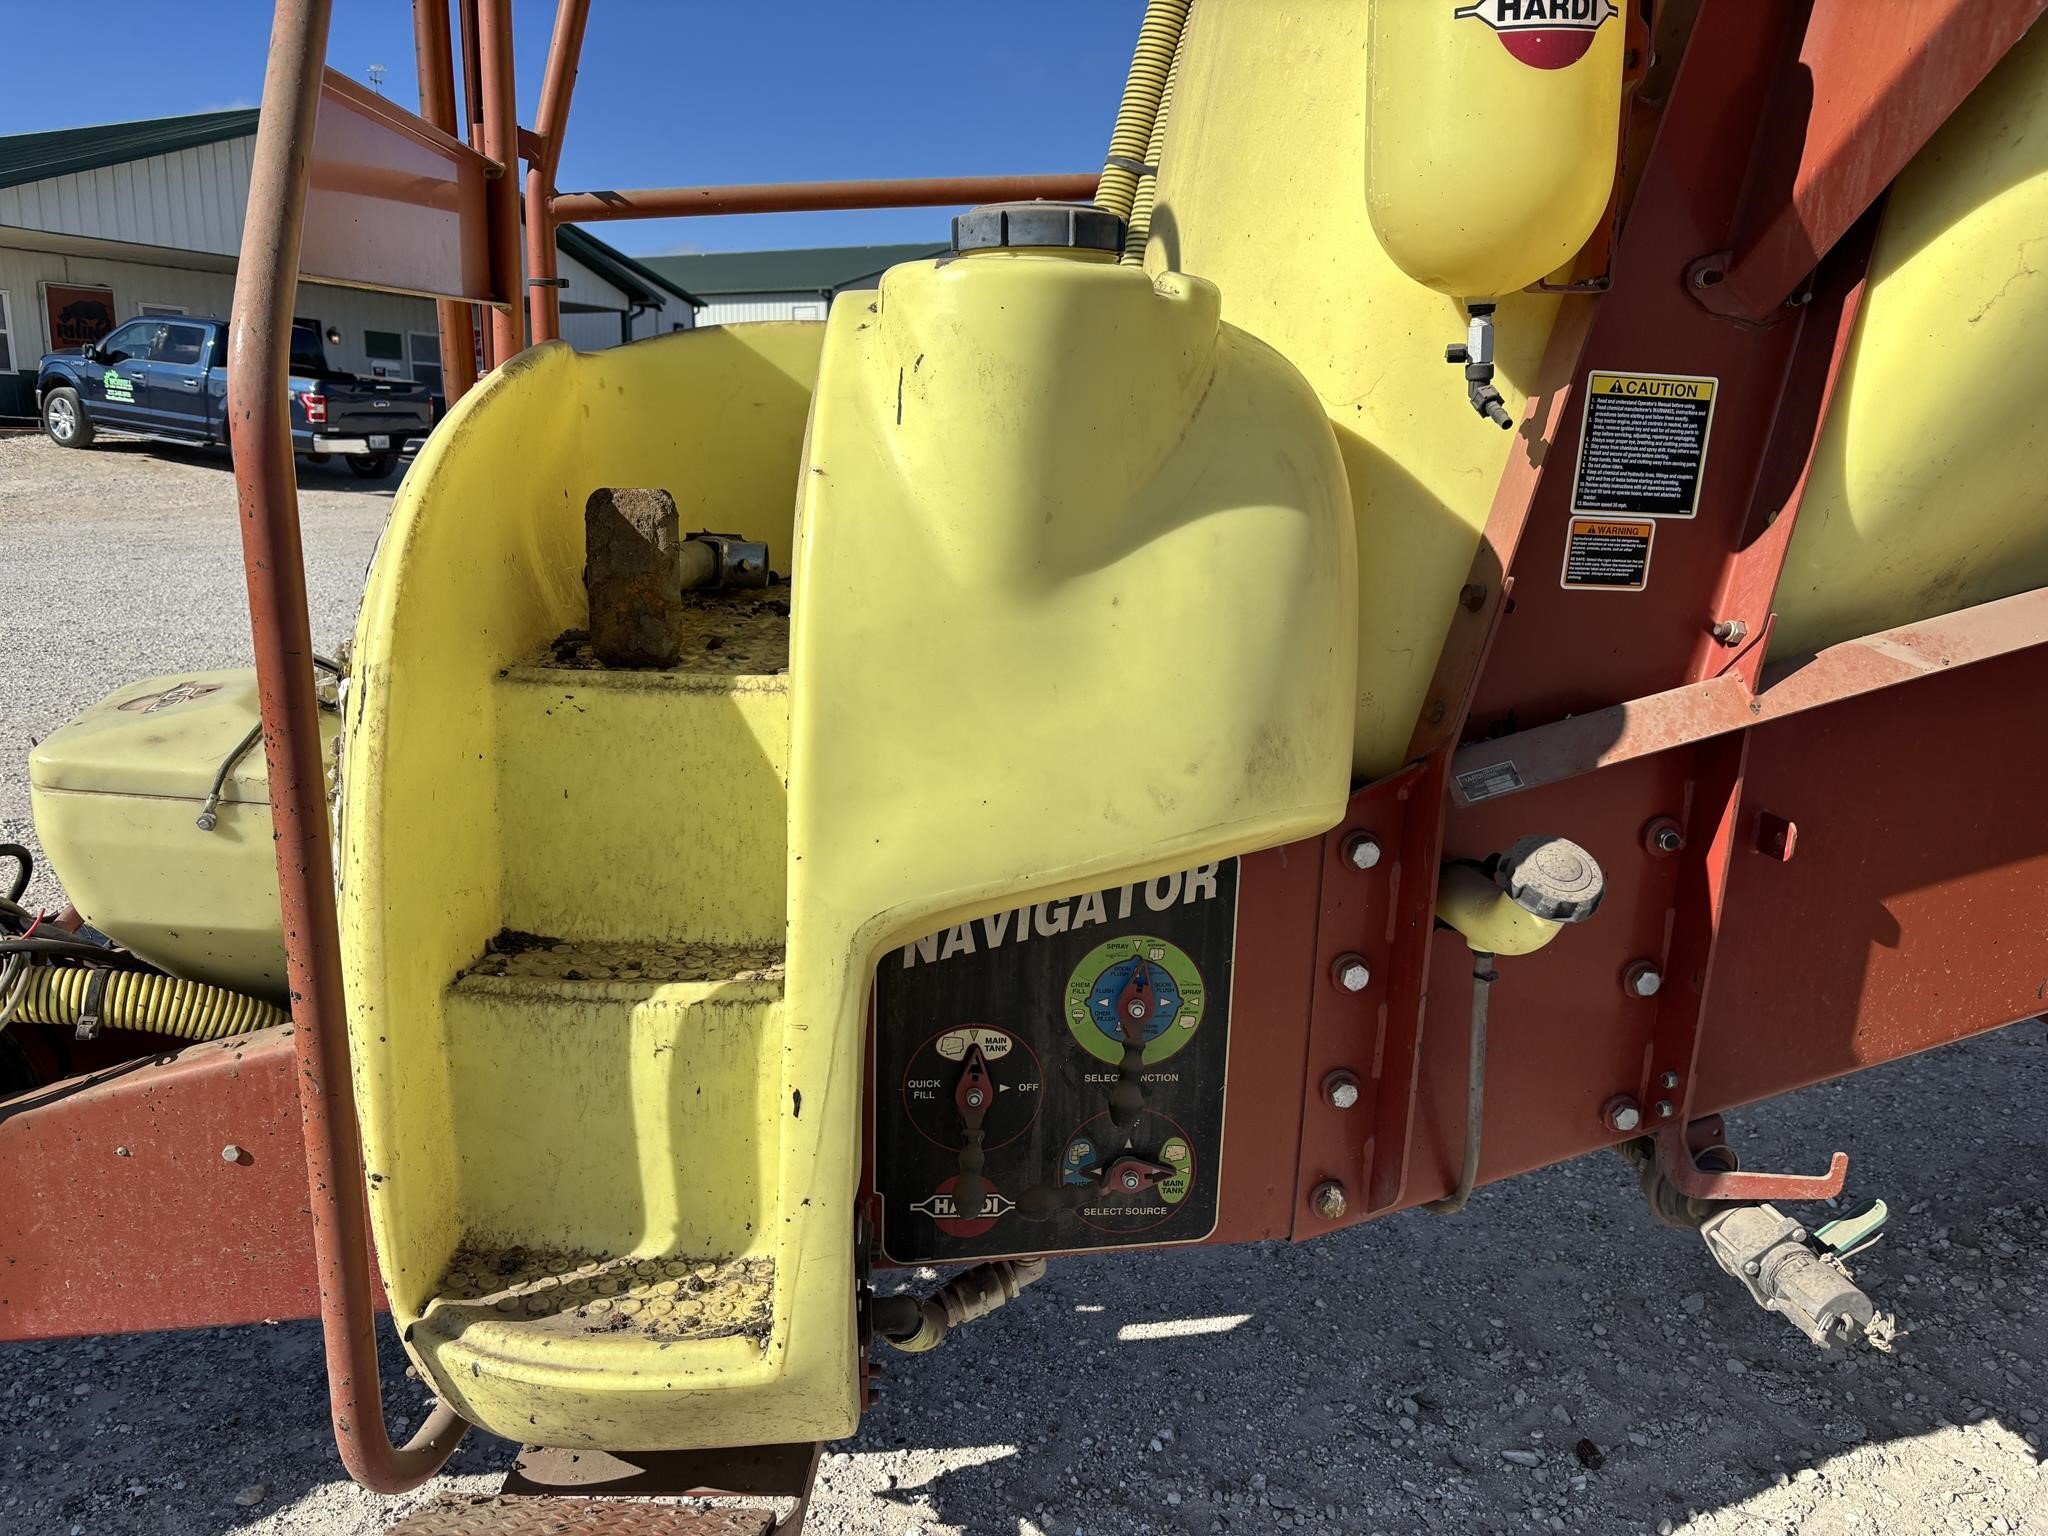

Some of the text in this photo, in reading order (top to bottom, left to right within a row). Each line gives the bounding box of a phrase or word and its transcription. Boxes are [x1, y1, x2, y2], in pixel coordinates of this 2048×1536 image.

[1497, 0, 1597, 22] HARDI
[1626, 381, 1698, 397] CAUTION
[1598, 526, 1639, 536] WARNING
[1084, 1074, 1120, 1082] SELEC
[908, 1080, 941, 1088] QUICK
[914, 1091, 935, 1099] FILL
[934, 1198, 998, 1214] HADI
[1084, 1207, 1167, 1216] SELECT SOURCE
